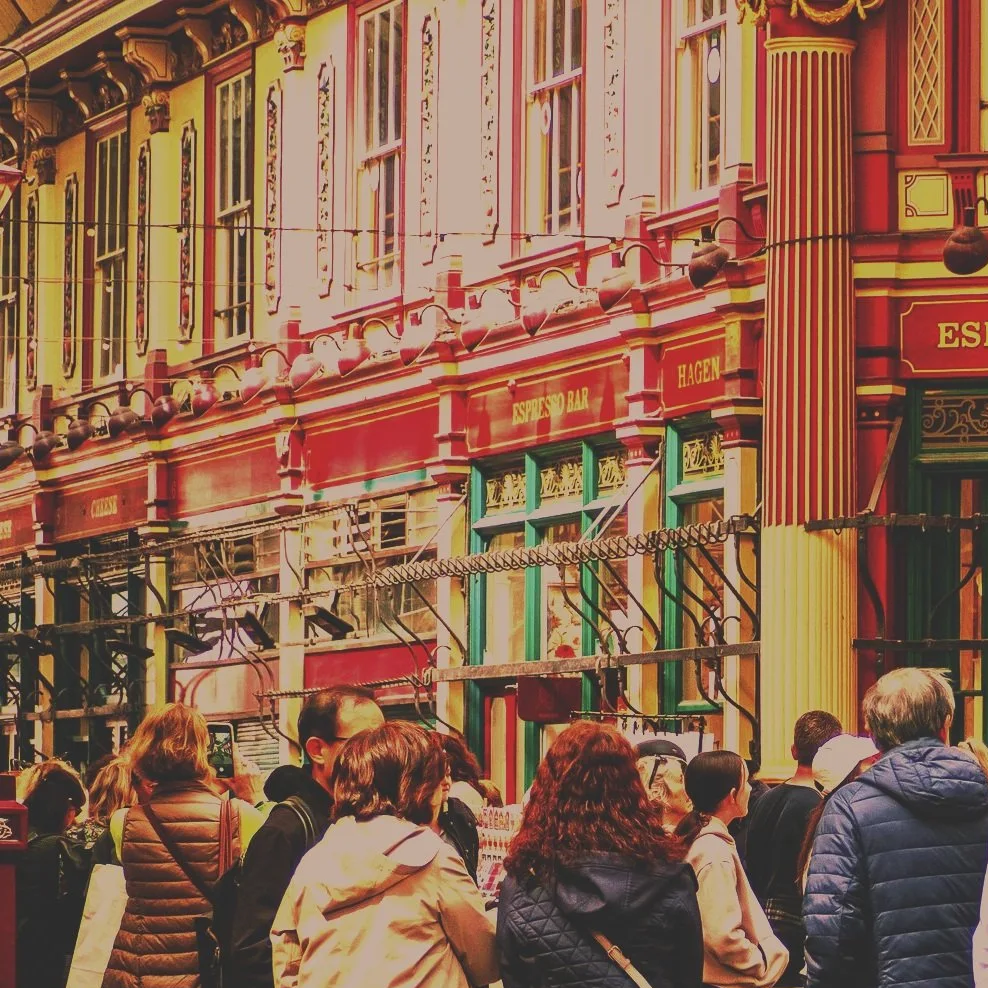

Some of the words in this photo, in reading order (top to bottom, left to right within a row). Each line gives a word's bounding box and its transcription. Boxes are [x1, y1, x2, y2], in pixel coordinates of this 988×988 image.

[677, 355, 720, 388] HAGEN
[512, 391, 564, 425] ESPRESSO
[567, 387, 588, 413] BAR
